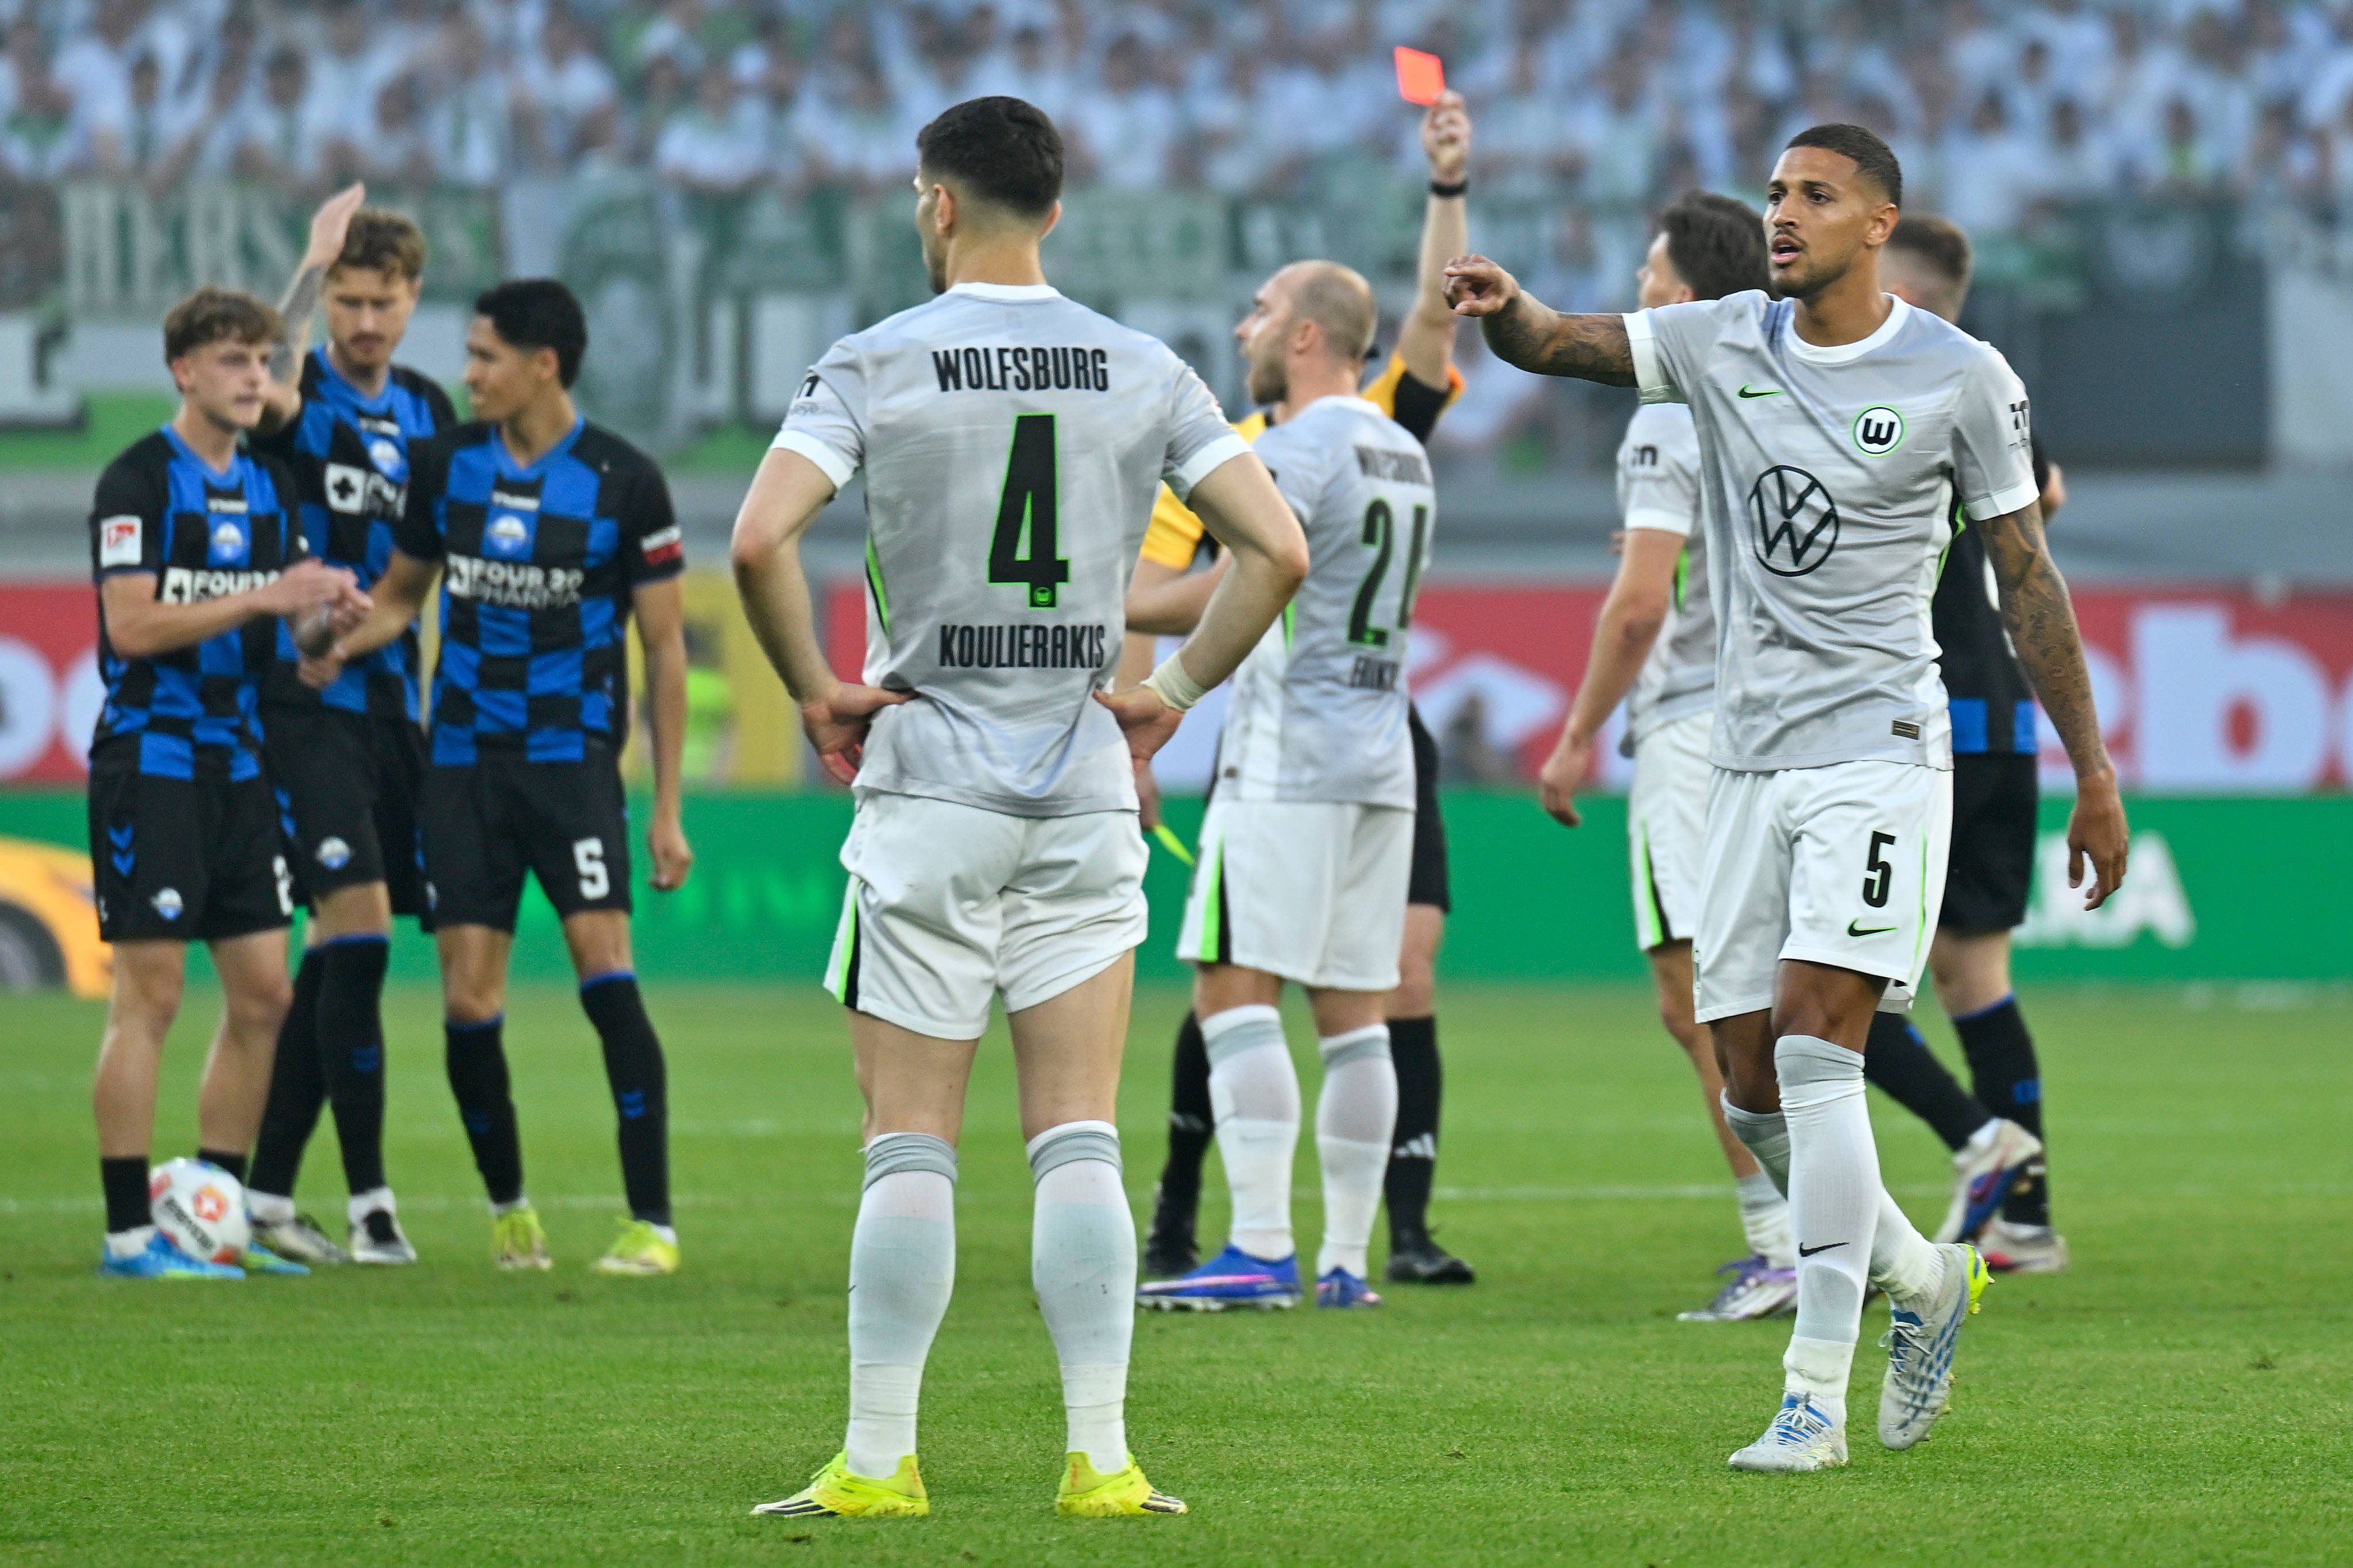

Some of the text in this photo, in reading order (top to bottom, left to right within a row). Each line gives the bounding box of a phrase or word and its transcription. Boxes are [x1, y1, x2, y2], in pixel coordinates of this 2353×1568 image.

[932, 346, 1109, 392] WOLFSBURG
[1863, 418, 1895, 446] W
[987, 412, 1070, 609] 4
[1347, 495, 1429, 646] 21
[940, 624, 1105, 668] KOULIERAKIS
[574, 837, 610, 900] 5
[1863, 830, 1896, 908] 5
